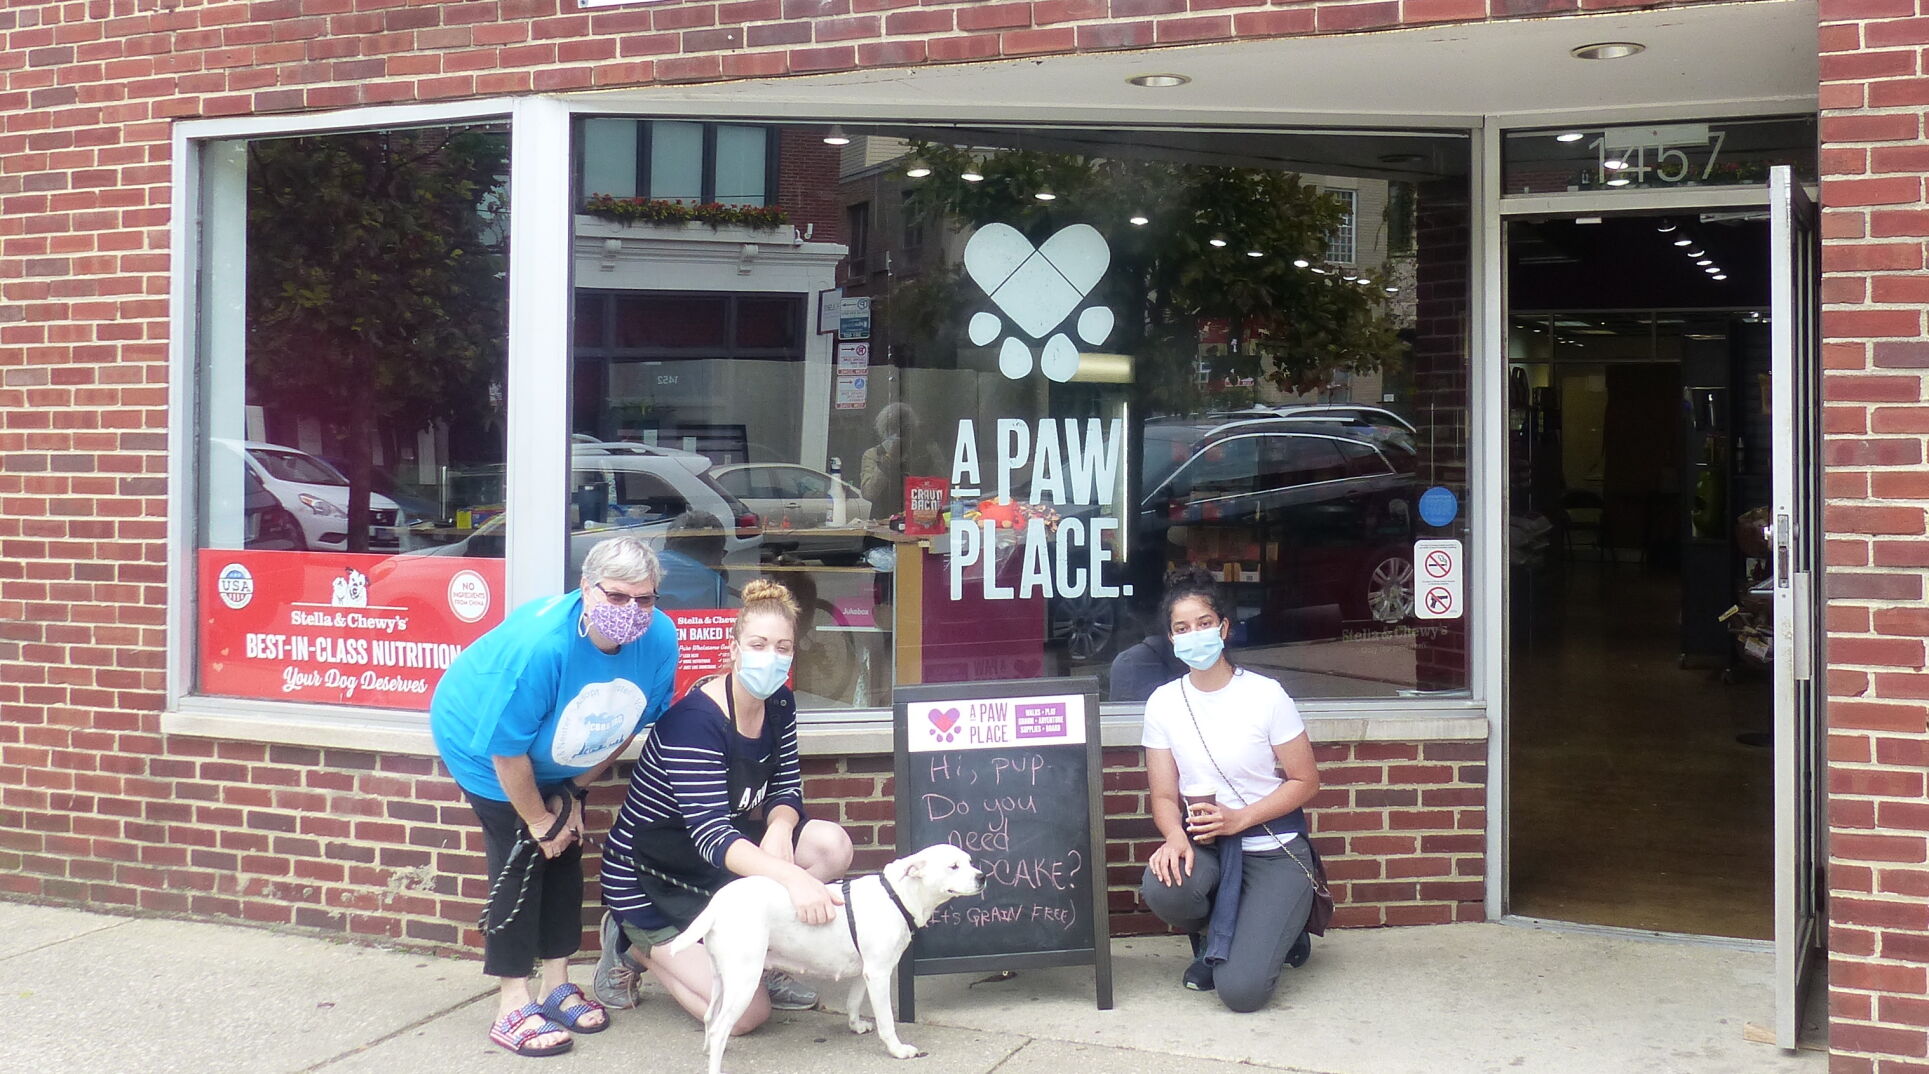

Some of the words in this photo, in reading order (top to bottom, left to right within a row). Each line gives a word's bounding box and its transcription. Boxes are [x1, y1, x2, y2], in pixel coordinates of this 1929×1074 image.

[1588, 131, 1726, 184] 1457
[950, 418, 981, 485] A
[997, 418, 1122, 506] PAW
[950, 517, 1134, 600] PLACE.
[222, 580, 251, 593] USA
[462, 582, 475, 591] NO
[290, 610, 334, 627] Stella
[333, 612, 347, 628] &
[347, 613, 407, 634] Chewy's
[676, 627, 687, 641] EN
[689, 627, 723, 641] BAKED
[677, 616, 704, 625] Stella
[712, 615, 738, 624] Chew
[246, 633, 368, 665] BEST-IN-CLASS
[281, 665, 323, 693] Your
[323, 667, 358, 698] Dog
[360, 670, 428, 694] Deserves
[969, 703, 977, 719] A
[979, 701, 1008, 723] PAW
[970, 725, 1008, 744] PLACE
[930, 754, 977, 785] Hi,
[922, 793, 970, 822] Do
[983, 795, 1037, 832] you
[948, 817, 1010, 852] need
[978, 849, 1082, 901] PCAKE?
